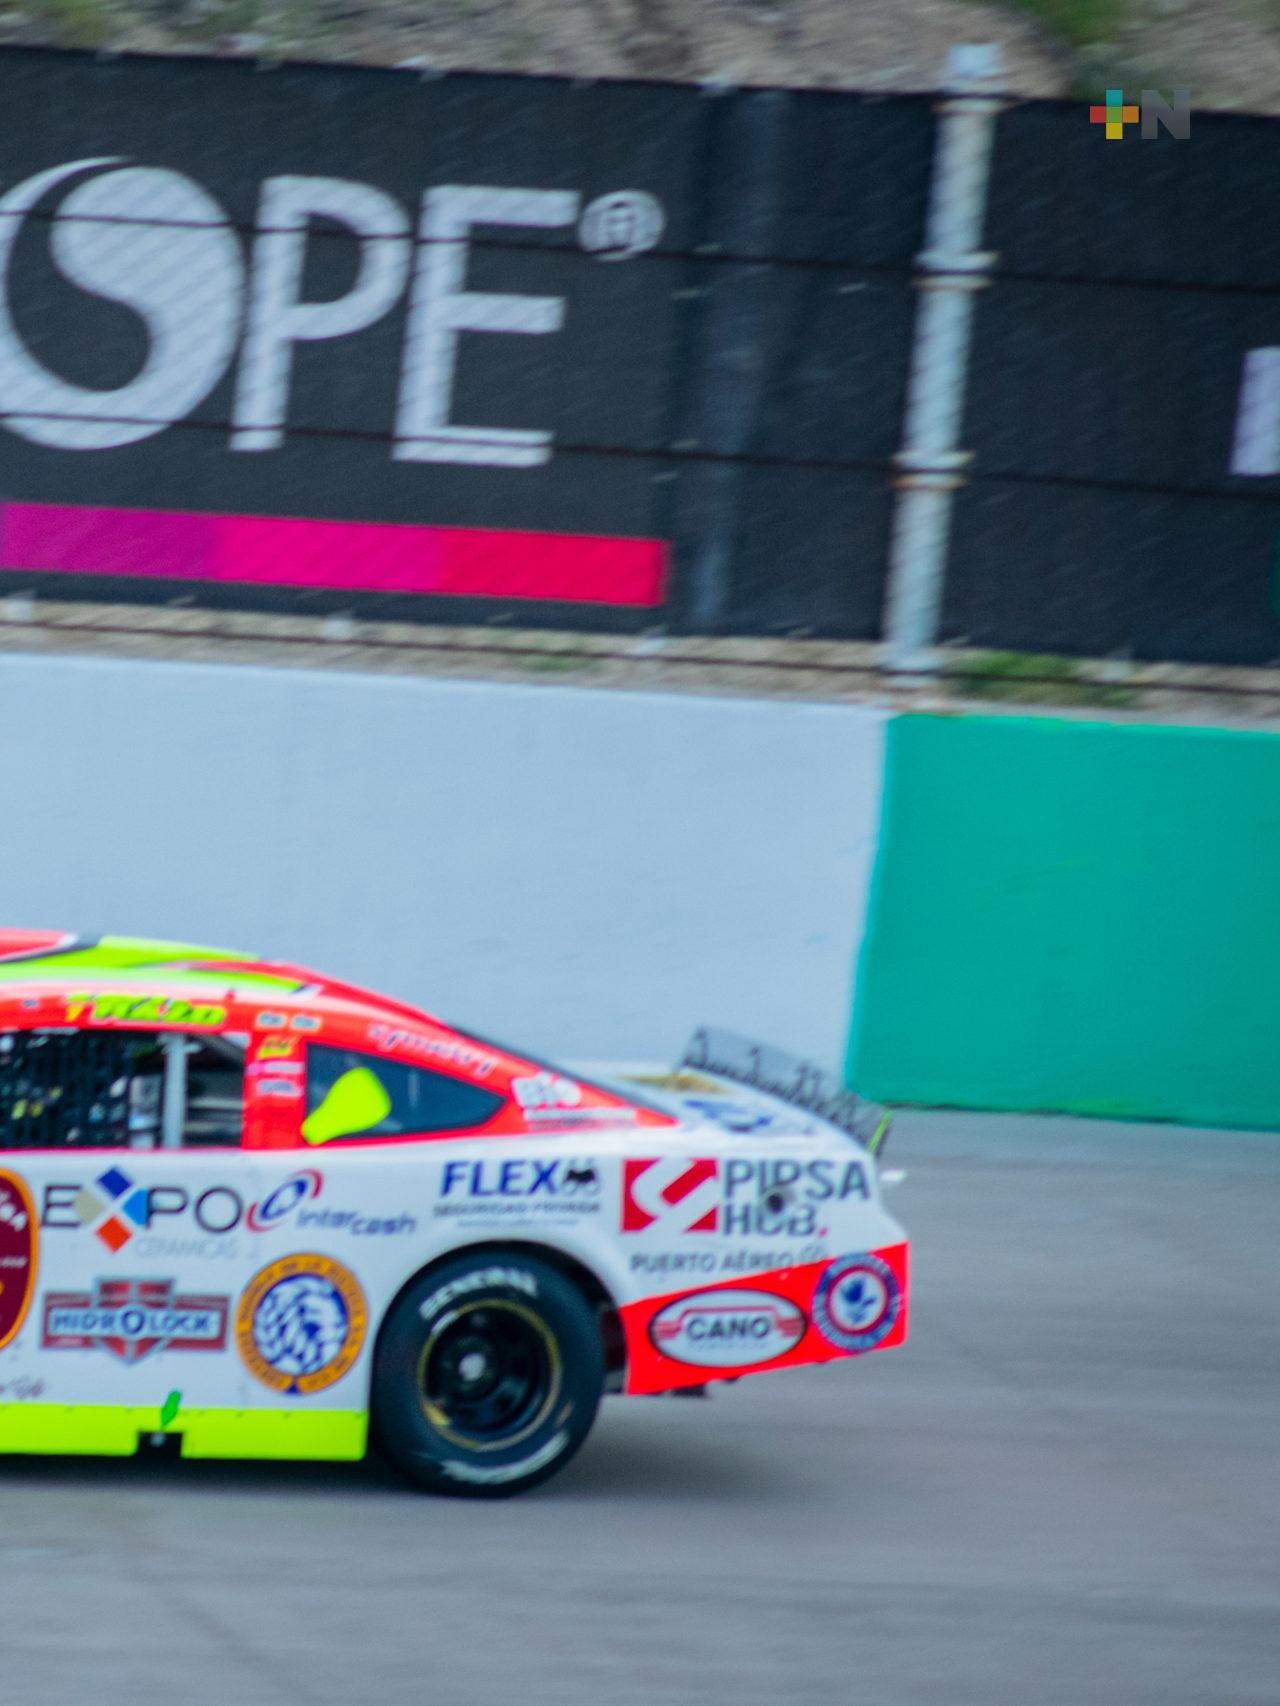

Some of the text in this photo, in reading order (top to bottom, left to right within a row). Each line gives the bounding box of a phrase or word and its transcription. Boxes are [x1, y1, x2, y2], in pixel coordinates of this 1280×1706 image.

[440, 1160, 561, 1197] FLEX
[724, 1159, 871, 1200] PIPSA
[686, 1317, 772, 1341] CANO
